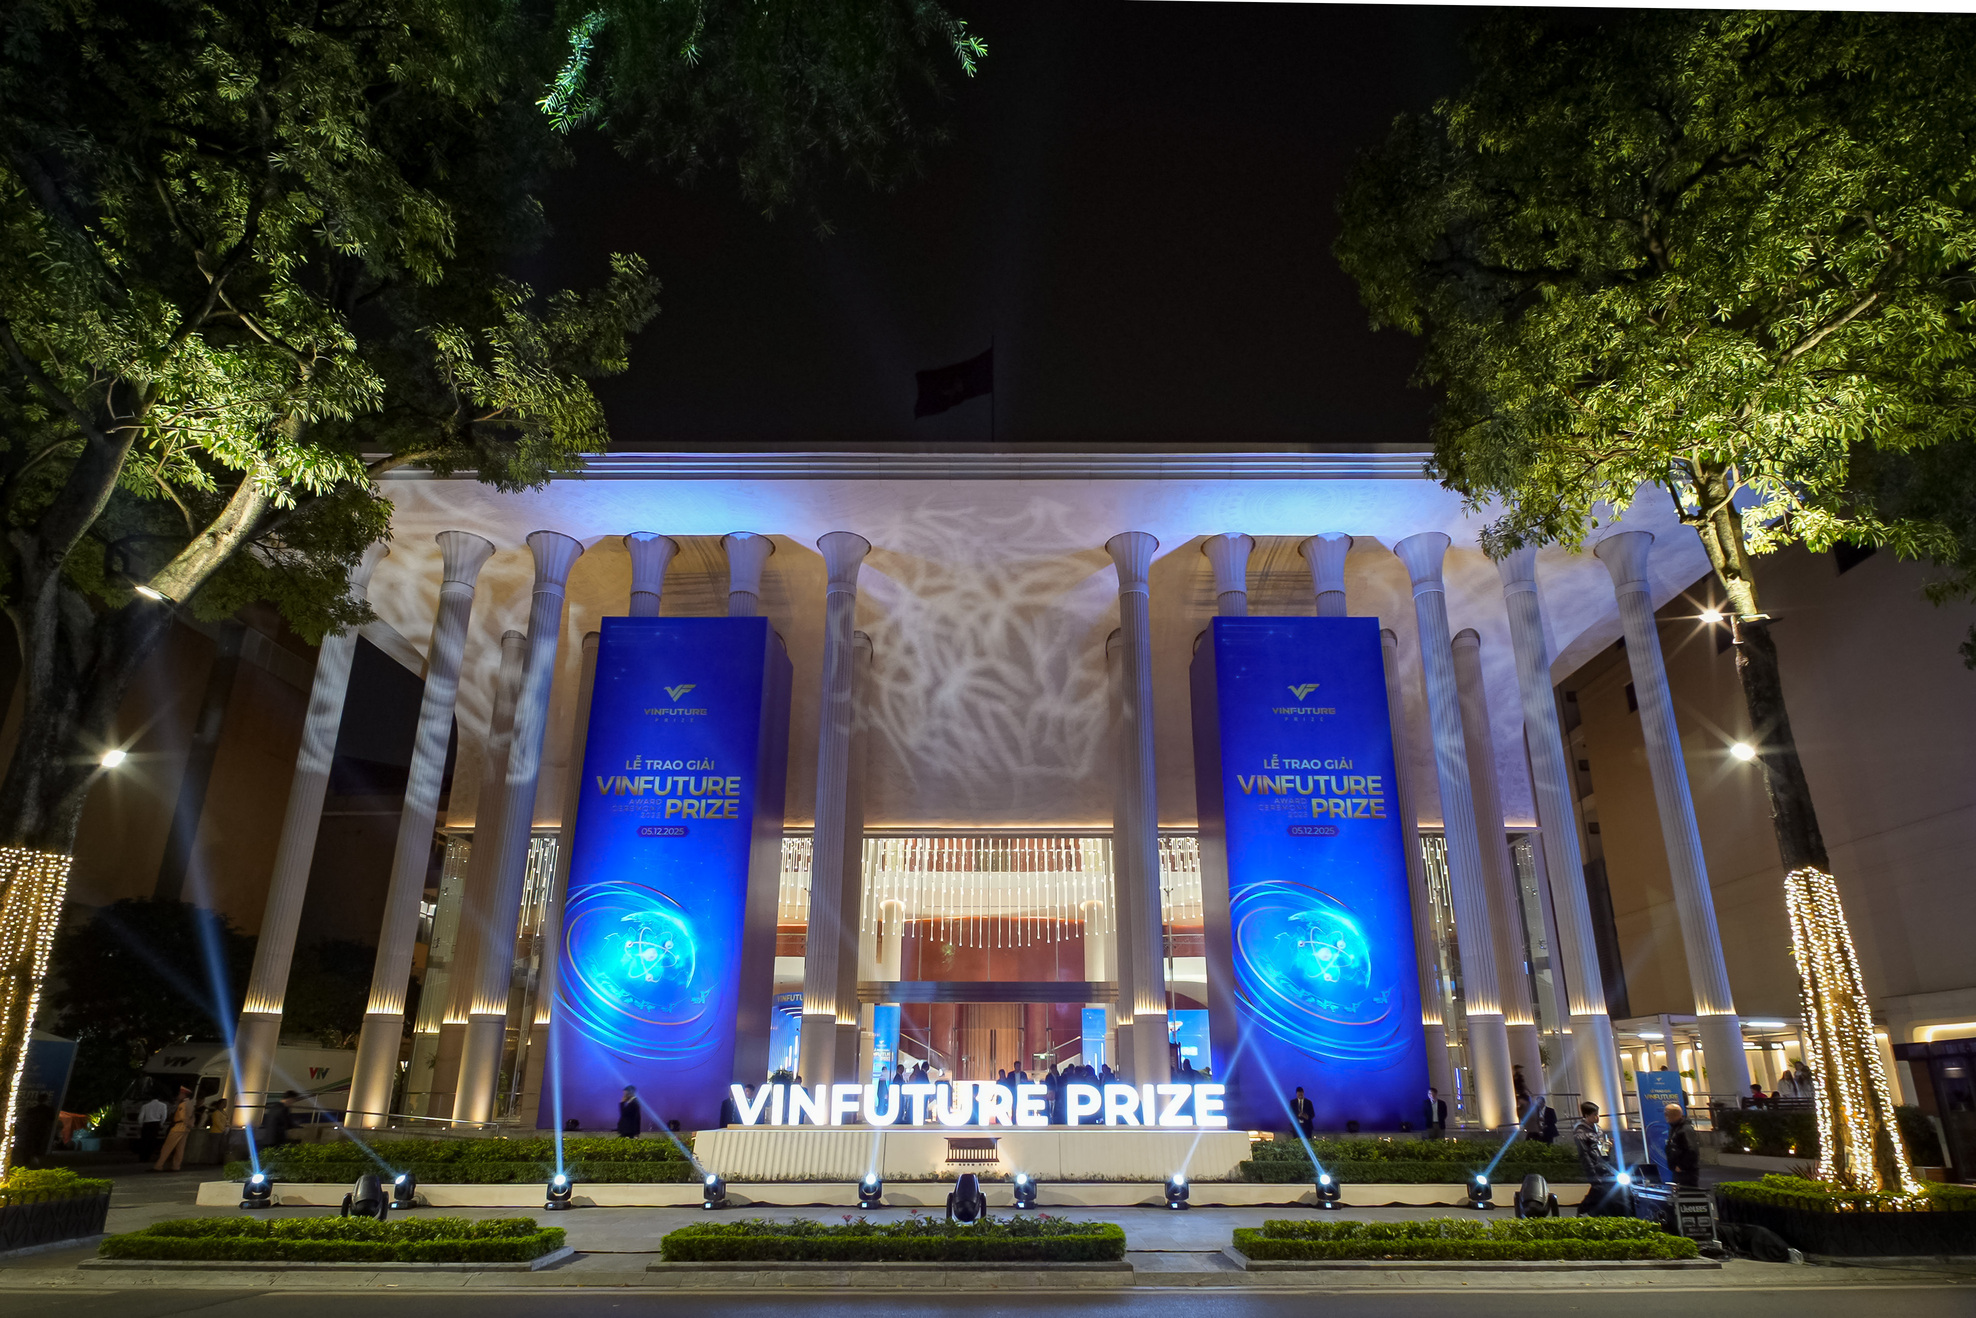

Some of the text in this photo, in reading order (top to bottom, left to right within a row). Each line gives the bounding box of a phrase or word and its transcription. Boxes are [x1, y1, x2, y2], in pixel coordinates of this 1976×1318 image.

[643, 708, 708, 716] VINFUTURE
[1272, 707, 1336, 715] VINFUTURE
[625, 755, 715, 771] LỄ TRAO GIẢI
[1263, 754, 1353, 770] LỄ TRAO GIẢI
[596, 776, 741, 796] VINFUTURE
[1236, 774, 1384, 795] VINFUTURE
[664, 799, 740, 819] PRIZE
[1311, 798, 1387, 819] PRIZE
[641, 827, 685, 836] 05.12.2025
[1291, 826, 1335, 835] 05.12.2025
[163, 1056, 197, 1068] VTV
[309, 1067, 330, 1080] VTV
[730, 1083, 1228, 1127] VINFUTURE PRIZE
